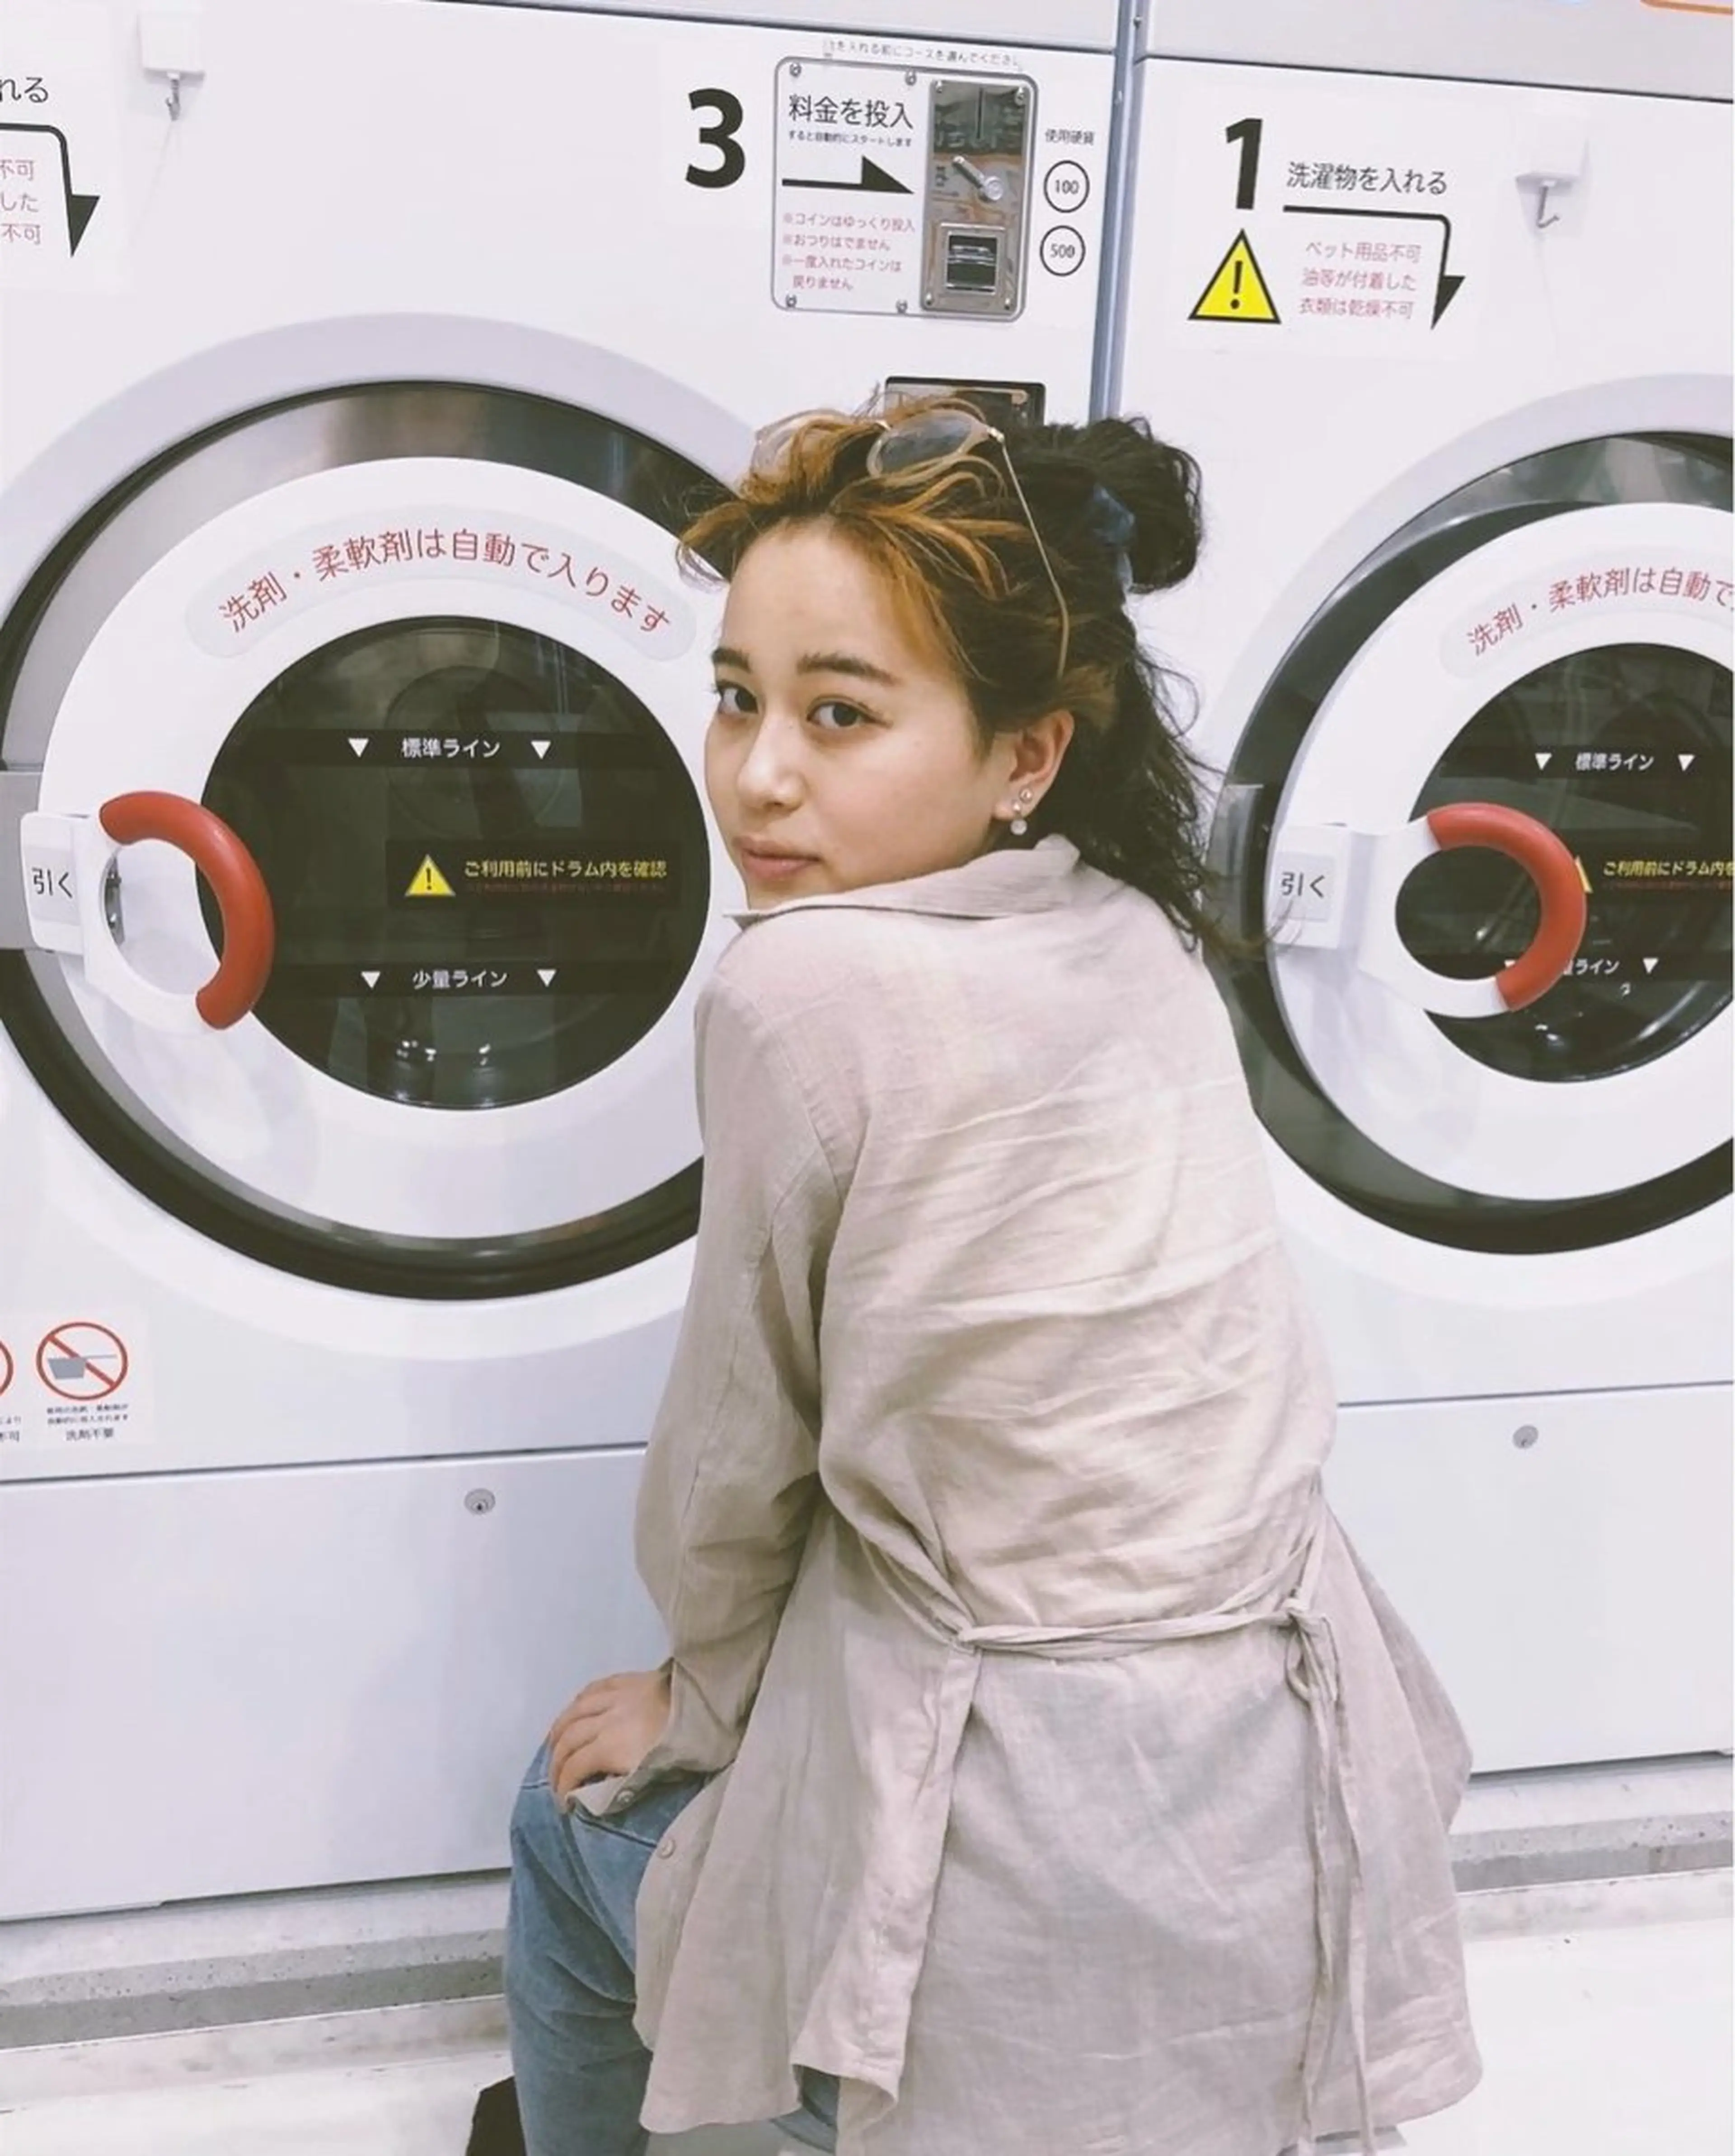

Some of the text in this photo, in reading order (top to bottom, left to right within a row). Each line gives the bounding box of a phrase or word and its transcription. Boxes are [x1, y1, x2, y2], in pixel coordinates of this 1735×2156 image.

[0, 76, 48, 103] れる
[788, 94, 913, 129] 料金を投入
[685, 88, 746, 188] 3
[1226, 118, 1262, 210] 1
[1054, 180, 1079, 195] 100
[1286, 161, 1447, 195] 洗濯物を入れる
[0, 192, 39, 213] した
[1, 224, 41, 245] 不可
[1050, 244, 1075, 258] 500
[792, 275, 853, 290] 戻りません
[218, 528, 671, 634] 洗剤・柔軟剤は自動で入ります
[1467, 566, 1734, 656] 洗剤・柔軟剤は自動で
[401, 738, 501, 759] 標準ライン
[1575, 752, 1655, 772] 標準ライン
[464, 860, 667, 879] ご利用前にドラム内を確認
[31, 866, 73, 898] 引く
[1280, 871, 1325, 898] 引く
[412, 968, 507, 990] 少量ライン
